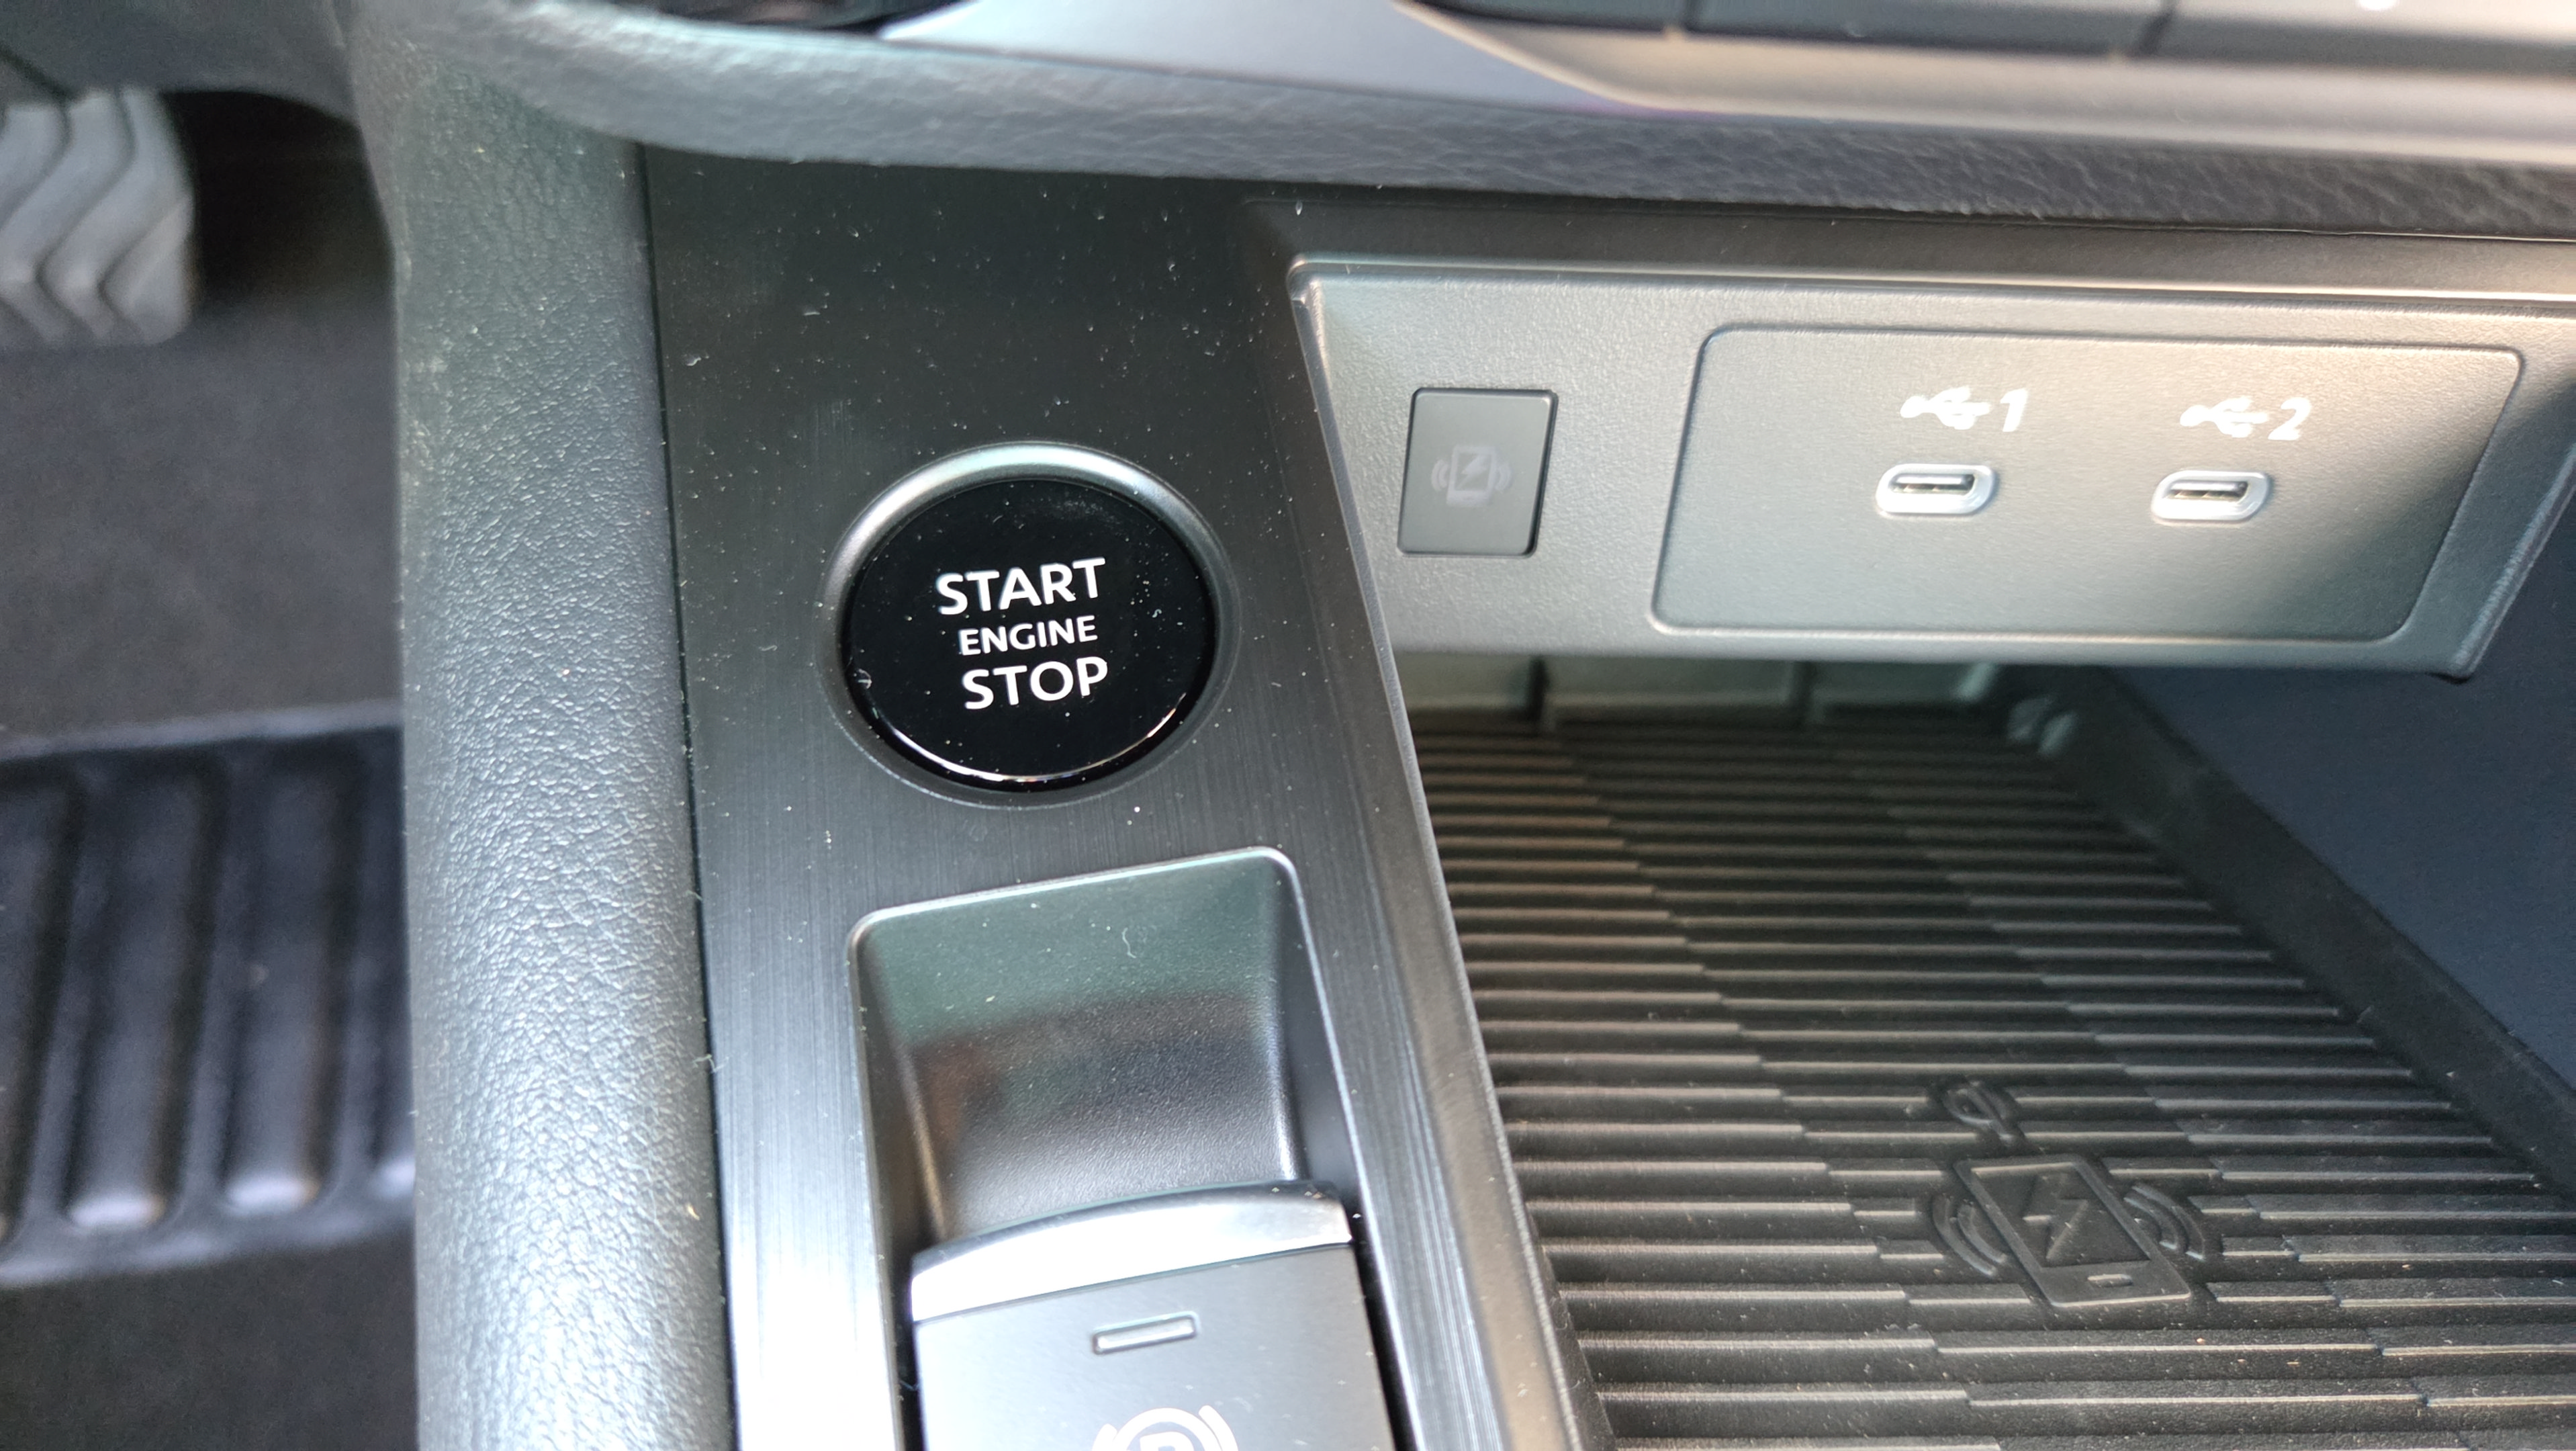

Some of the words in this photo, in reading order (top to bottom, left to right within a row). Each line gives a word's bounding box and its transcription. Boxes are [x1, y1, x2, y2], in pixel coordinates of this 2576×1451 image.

[2000, 388, 2028, 432] 1
[2268, 398, 2311, 440] 2
[936, 557, 1106, 615] START
[958, 615, 1098, 656] ENGINE
[962, 656, 1108, 709] STOP
